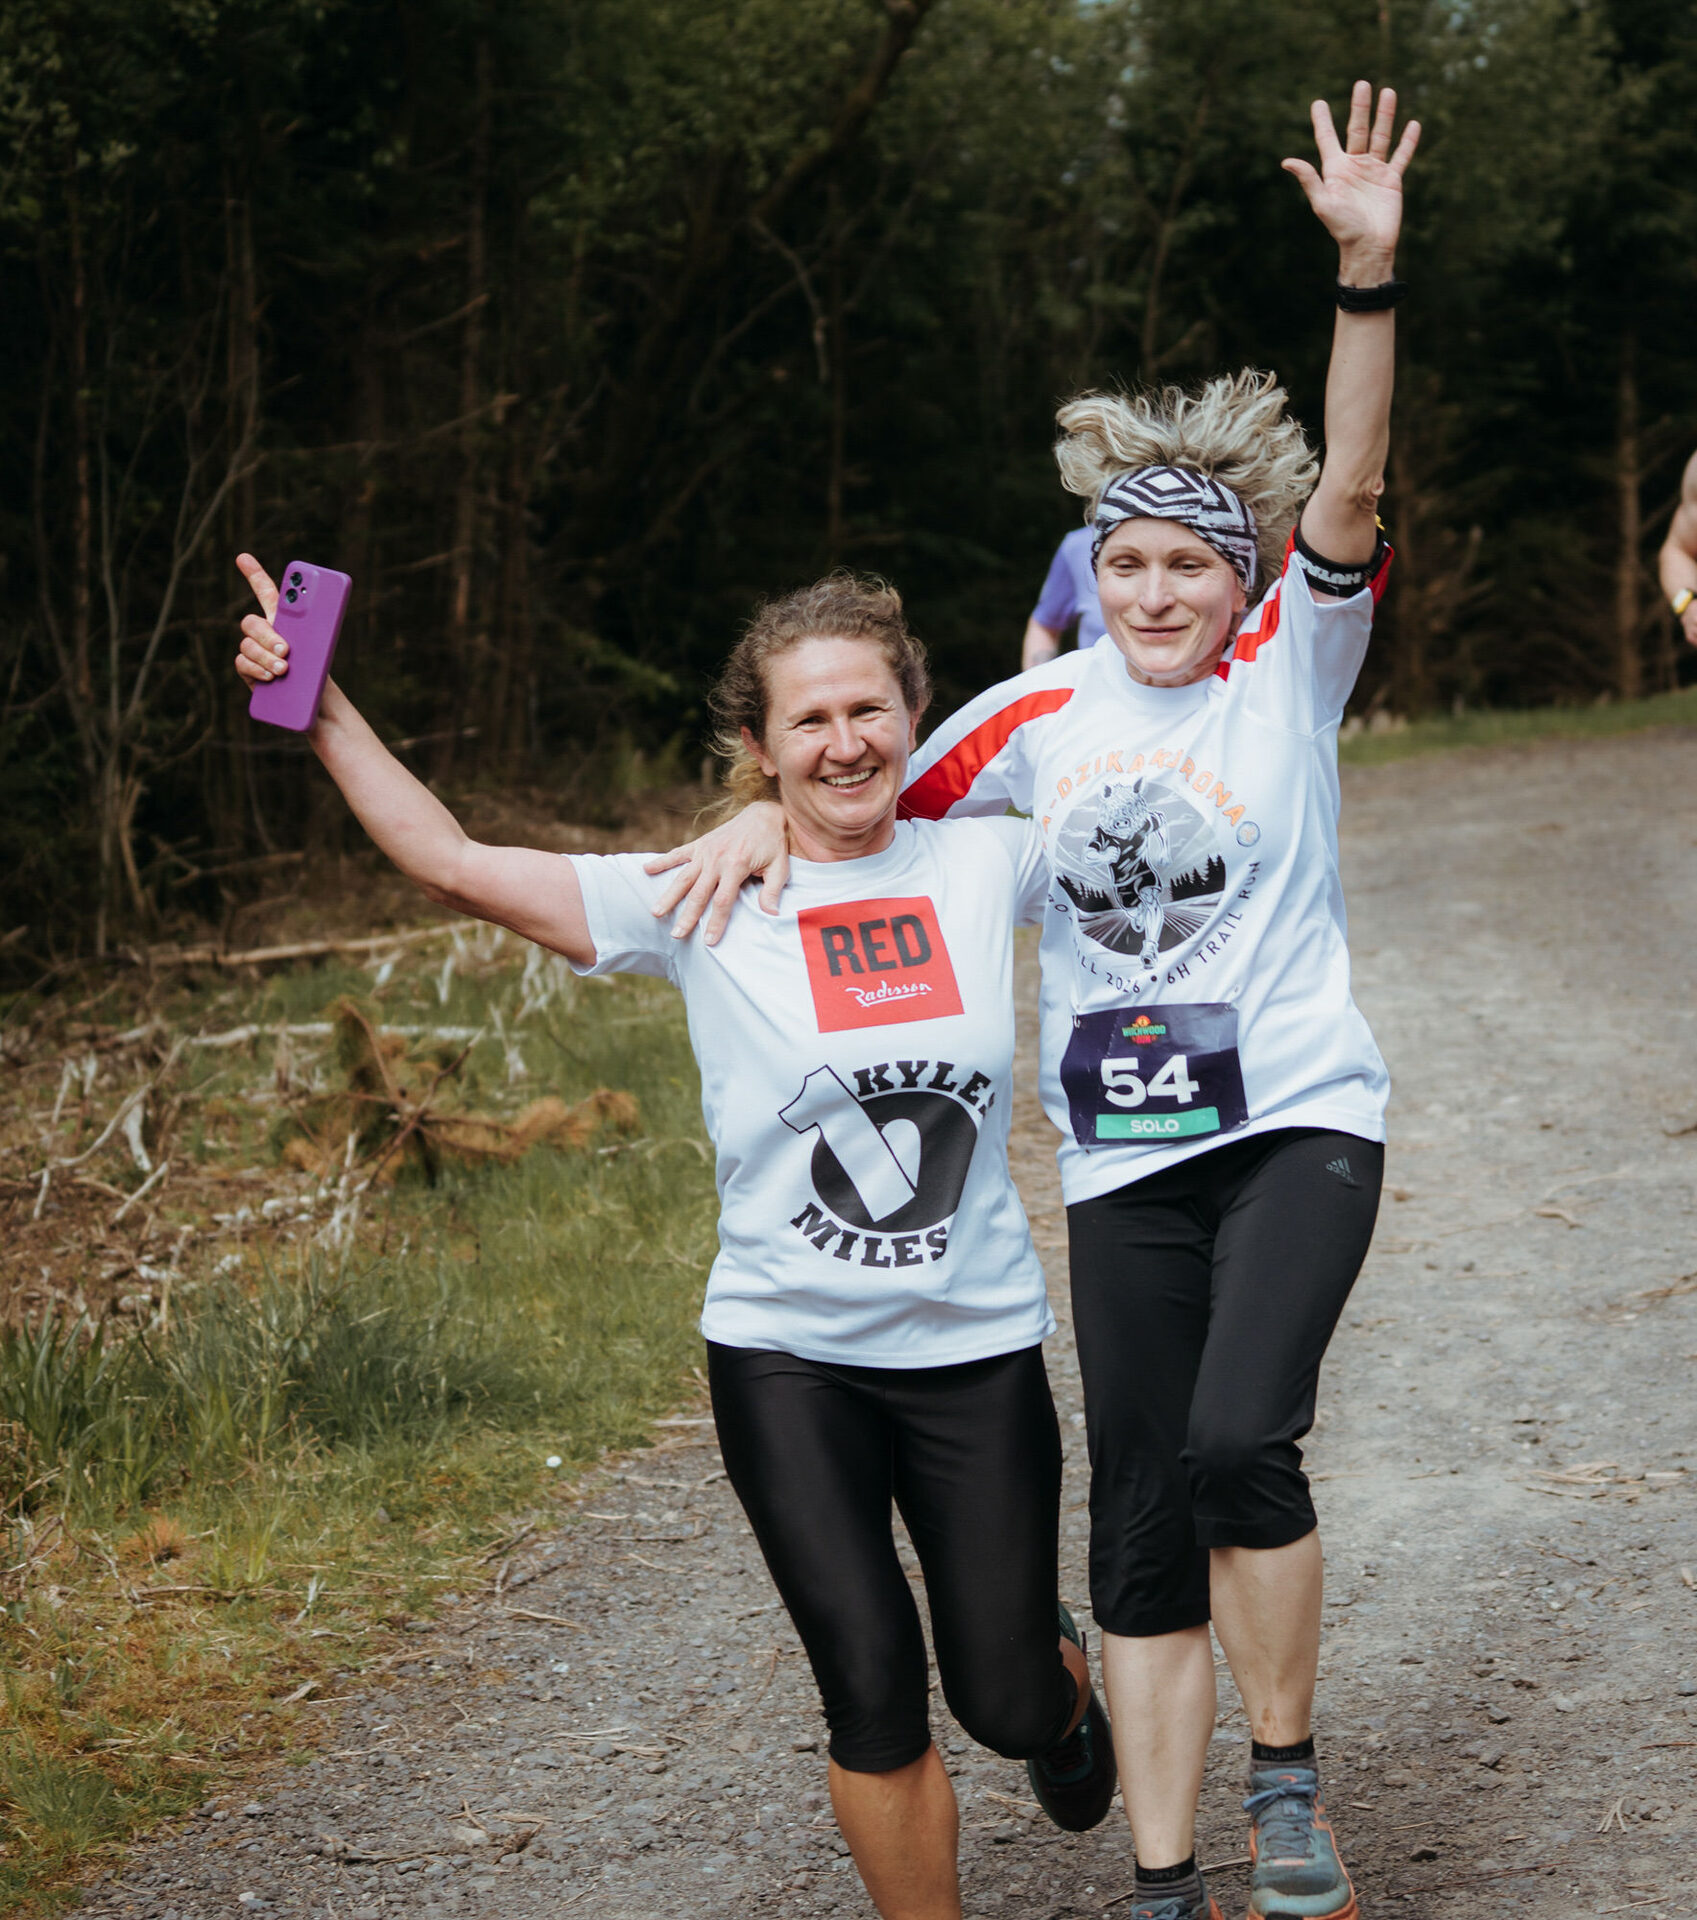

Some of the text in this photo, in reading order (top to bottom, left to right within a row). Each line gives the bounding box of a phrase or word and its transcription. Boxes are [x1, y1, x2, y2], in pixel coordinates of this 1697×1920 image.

[820, 913, 932, 977] RED
[1167, 963, 1191, 985] 6H
[1196, 910, 1244, 964] TRAIL
[1238, 860, 1261, 899] RUN
[845, 980, 932, 1007] Radisson
[1101, 1054, 1200, 1108] 54
[1130, 1118, 1180, 1133] SOLO
[790, 1202, 948, 1268] MILES
